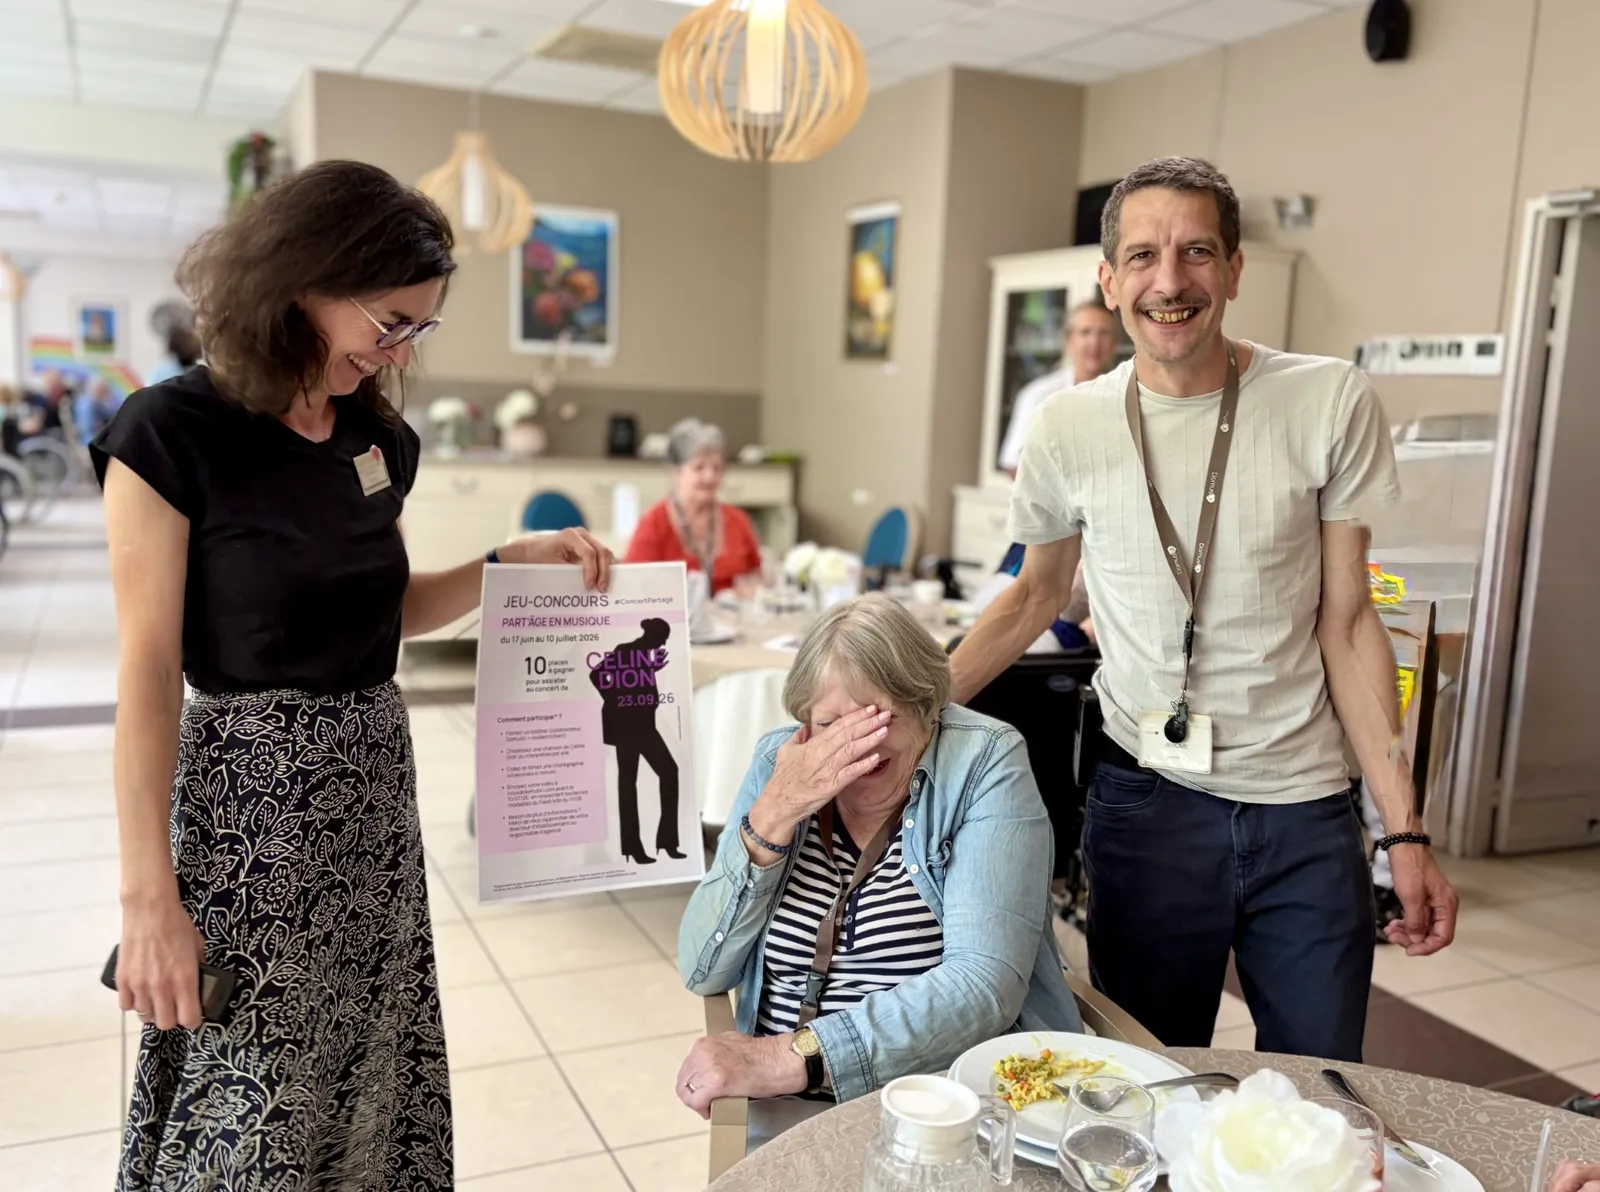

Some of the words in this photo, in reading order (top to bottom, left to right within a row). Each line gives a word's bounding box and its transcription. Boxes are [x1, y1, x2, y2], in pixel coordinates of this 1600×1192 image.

[503, 595, 609, 608] JEU-CONCOURS
[502, 615, 548, 628] PART'ÂGE
[549, 617, 562, 626] EN
[563, 616, 610, 626] MUSIQUE
[520, 635, 534, 645] juin
[555, 634, 577, 644] juillet
[578, 634, 600, 642] 2026
[525, 656, 546, 675] 10
[586, 648, 667, 670] CELINE
[553, 667, 575, 675] gagner
[599, 668, 656, 690] DION
[618, 692, 675, 707] 23.09.26
